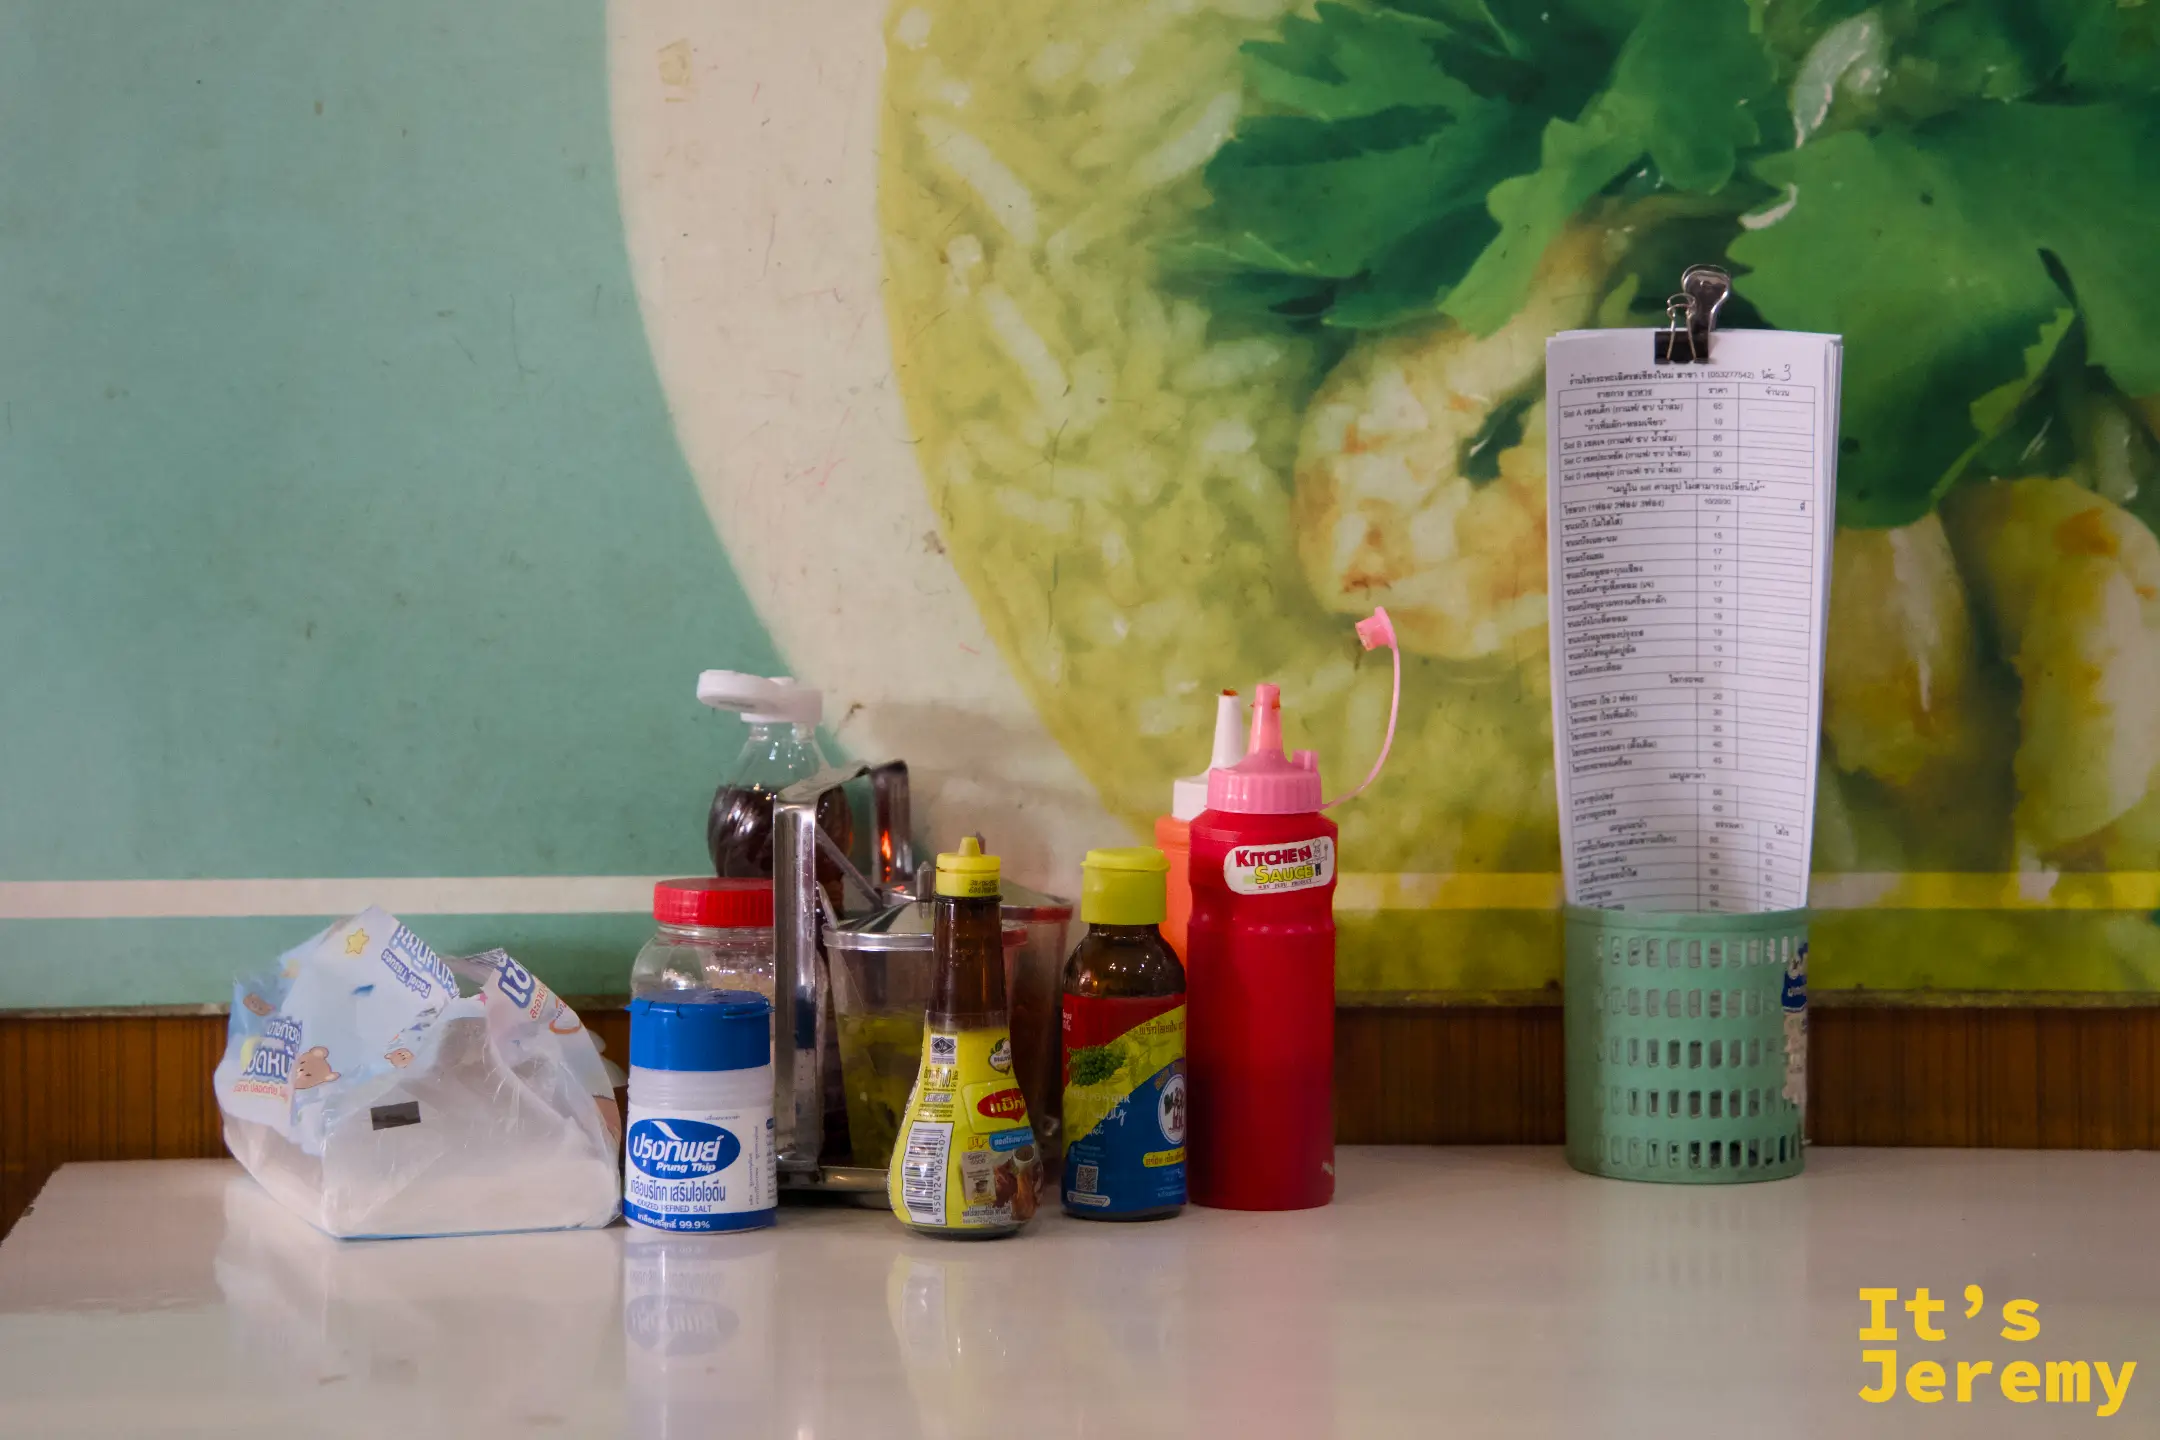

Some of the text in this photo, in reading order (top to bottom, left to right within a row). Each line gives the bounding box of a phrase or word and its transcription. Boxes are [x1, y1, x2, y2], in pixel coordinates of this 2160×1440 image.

[1780, 363, 1792, 381] 3
[1235, 845, 1313, 867] KITCHEN
[1254, 864, 1315, 884] SAUCE
[381, 949, 431, 998] Facial Tissues
[632, 1125, 724, 1167] ปรุงทิพย์
[656, 1162, 717, 1174] Prung Thip
[693, 1205, 713, 1213] SALT
[679, 1221, 711, 1229] 99.9%
